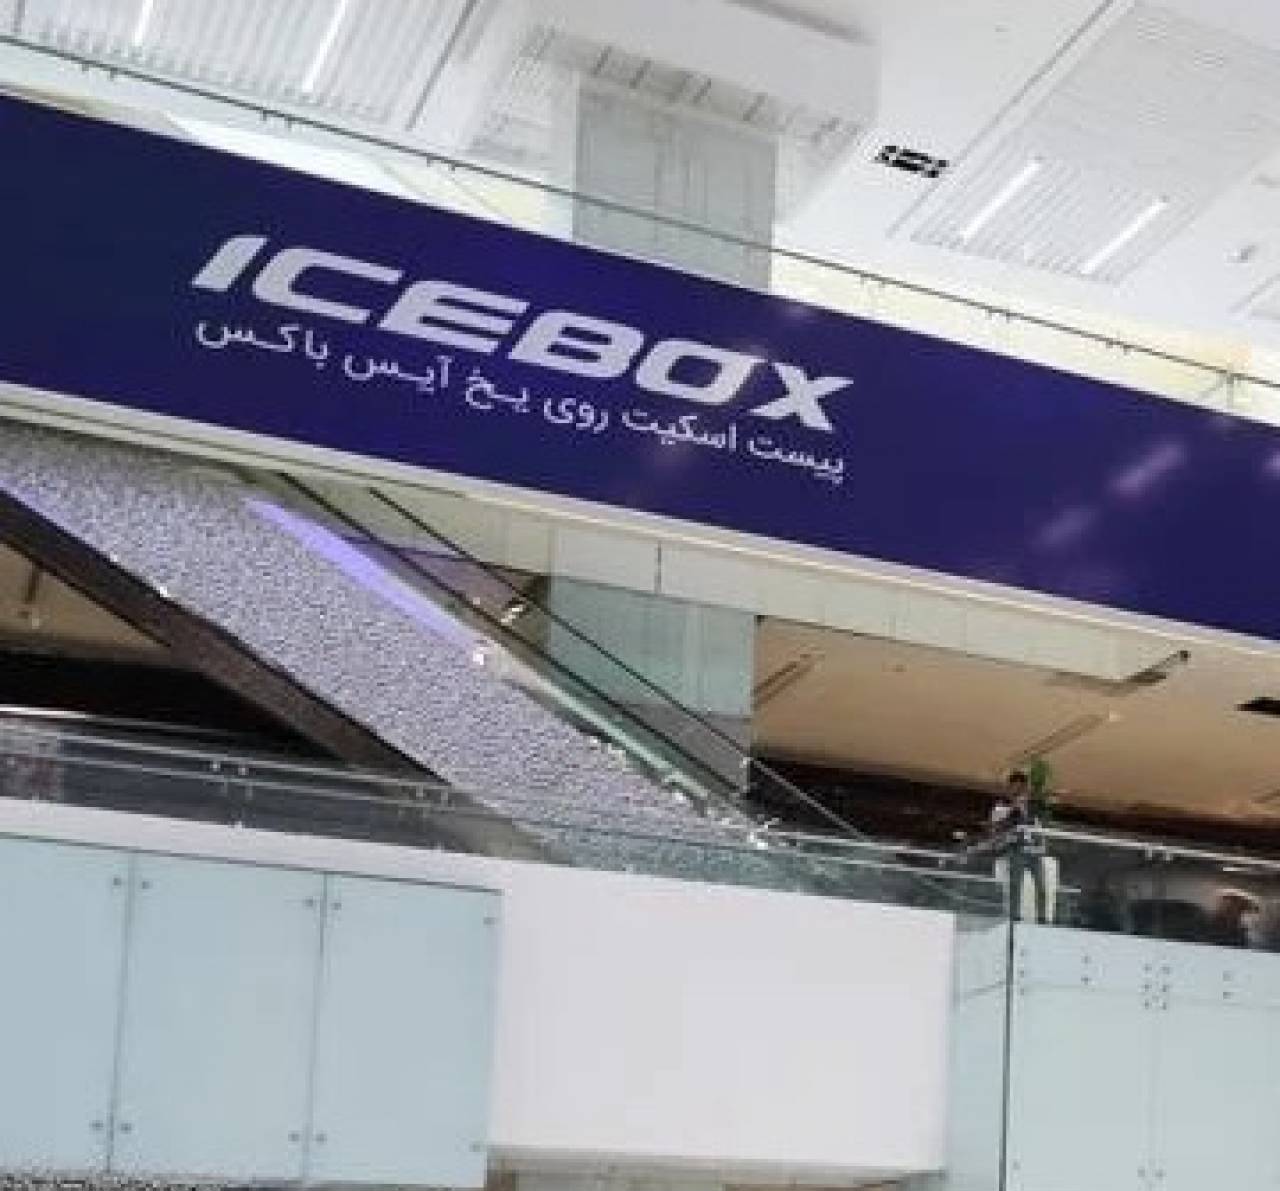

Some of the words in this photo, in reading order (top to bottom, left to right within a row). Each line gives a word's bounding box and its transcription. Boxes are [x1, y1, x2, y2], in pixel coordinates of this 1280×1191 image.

[191, 234, 855, 432] ICEBOX
[195, 319, 329, 368] باکس
[343, 353, 454, 394] آیس
[464, 367, 531, 413] یخ
[543, 397, 610, 434] روی
[620, 408, 738, 452] اسکیت
[747, 434, 845, 485] پیست
